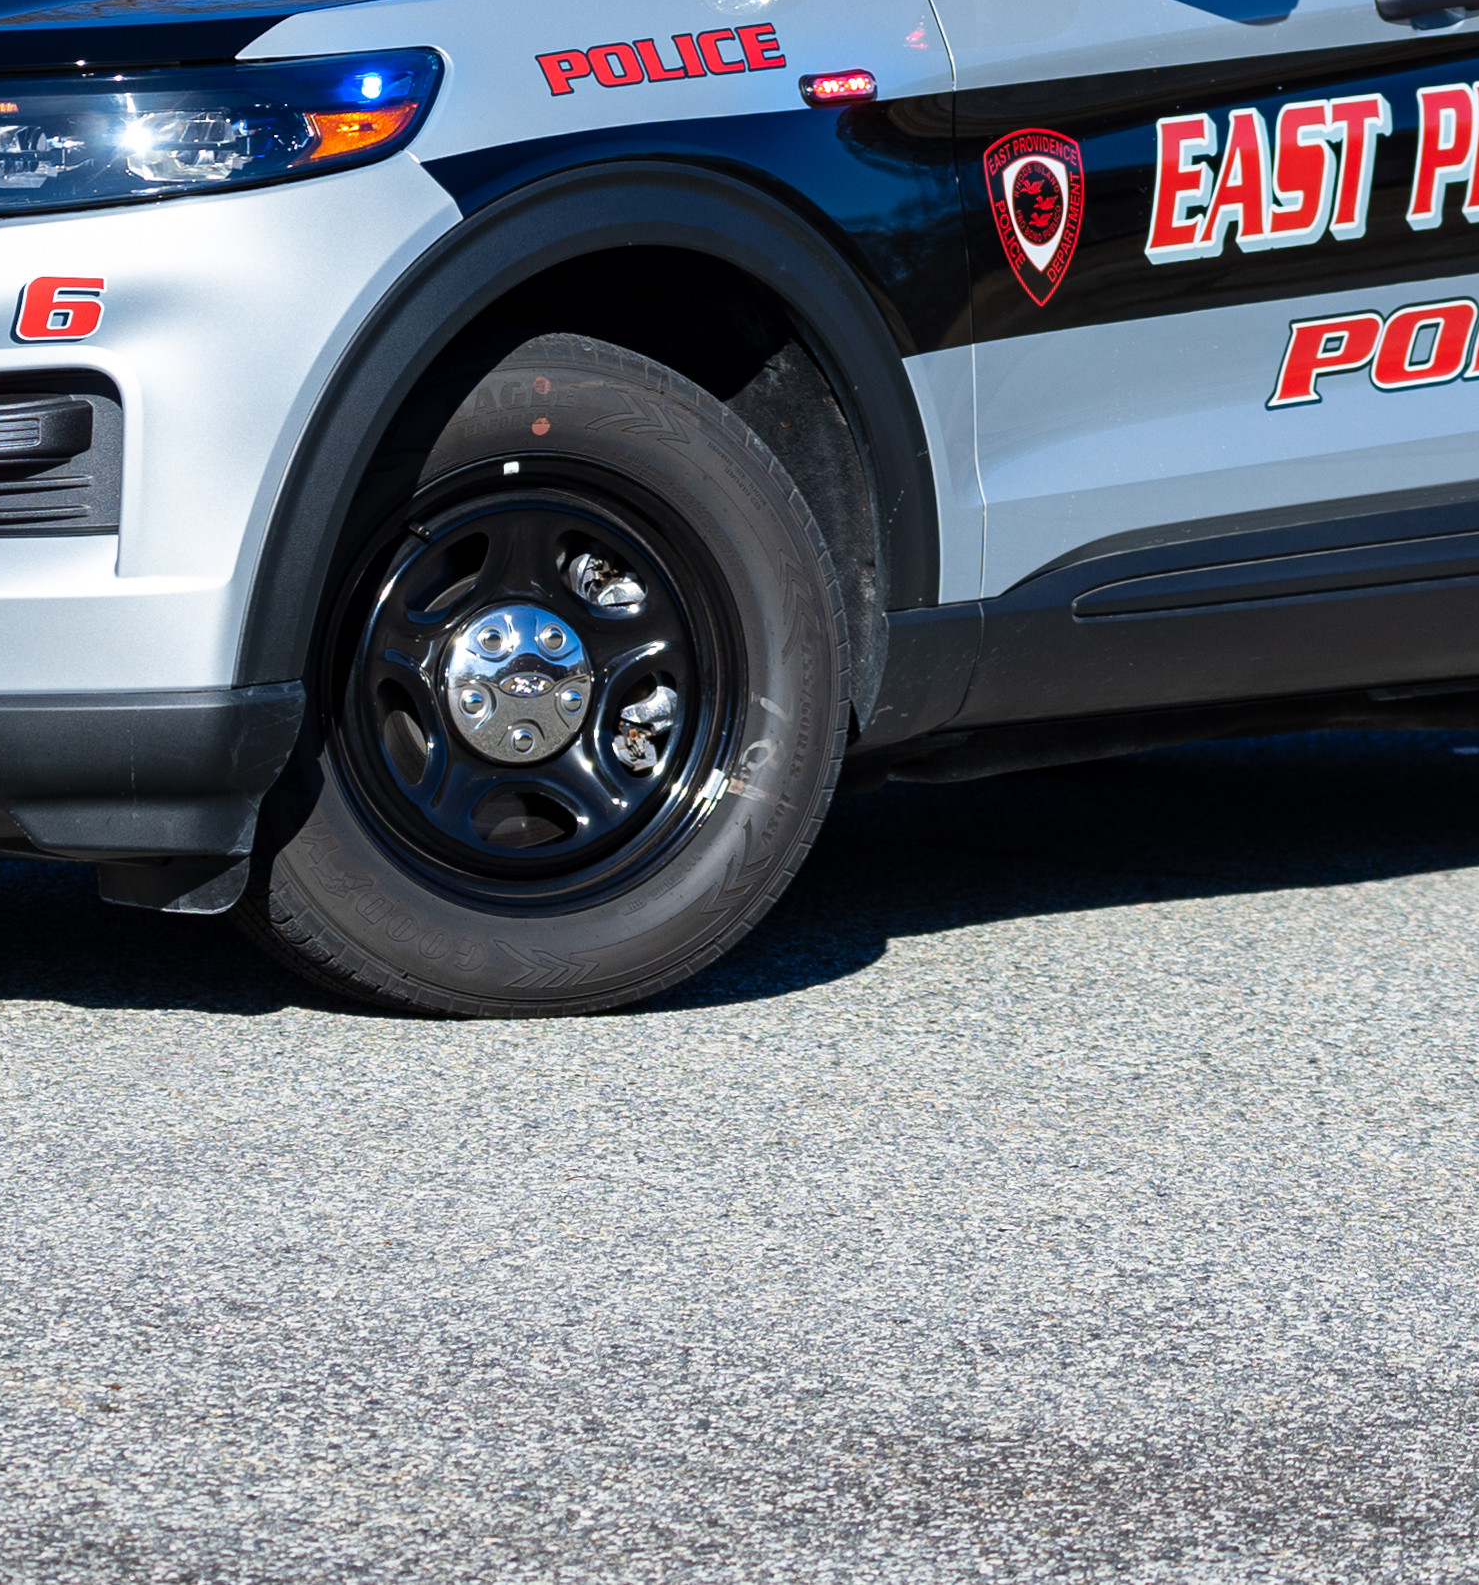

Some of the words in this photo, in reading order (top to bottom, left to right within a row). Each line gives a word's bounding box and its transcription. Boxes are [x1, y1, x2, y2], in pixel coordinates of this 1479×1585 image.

[535, 22, 787, 97] POLICE
[988, 144, 1010, 176] EAST
[1013, 135, 1078, 166] PROVIDENCE
[1144, 92, 1392, 265] EAST
[995, 200, 1026, 269] POLICE
[1046, 171, 1080, 283] DEPARTMENT
[10, 275, 107, 345] 6
